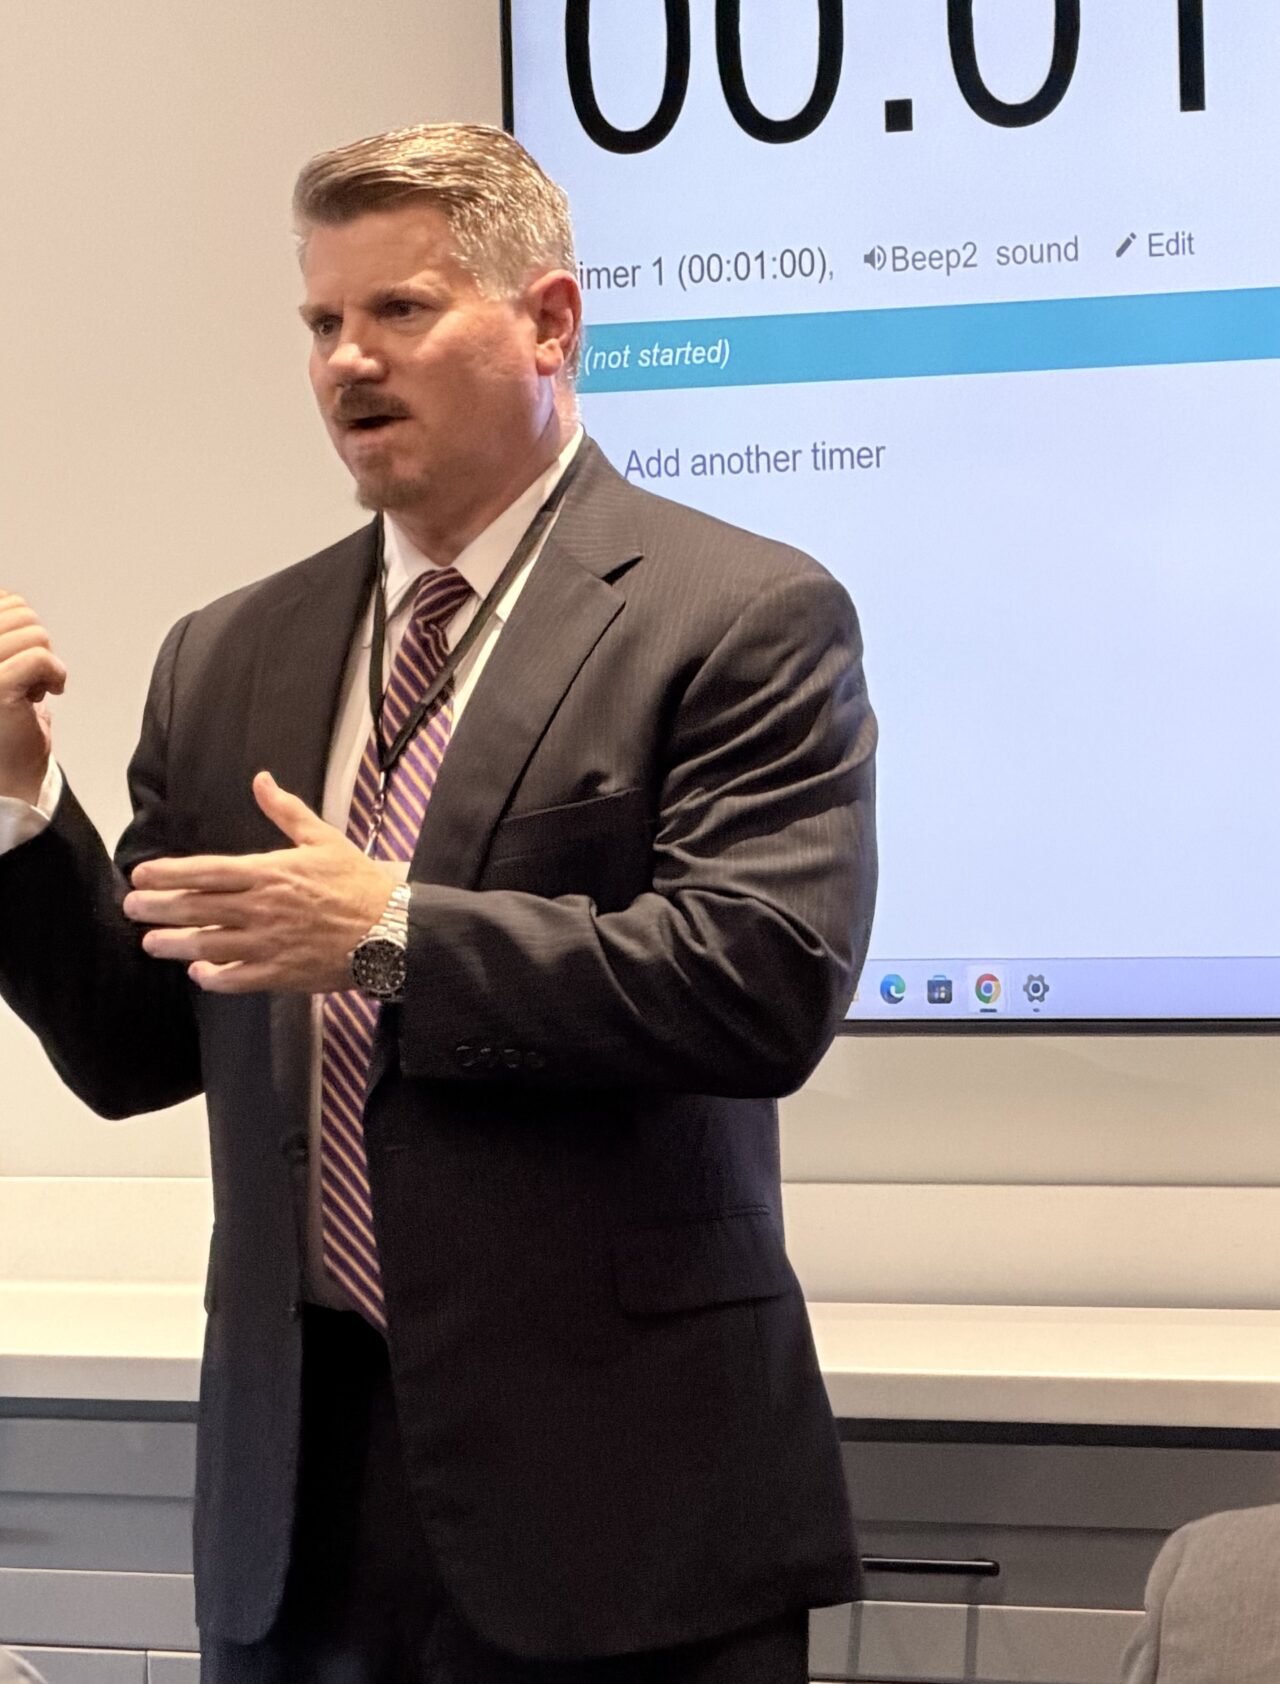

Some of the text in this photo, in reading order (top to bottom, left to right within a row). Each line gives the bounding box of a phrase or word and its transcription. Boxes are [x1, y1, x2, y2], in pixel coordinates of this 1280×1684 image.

[575, 230, 1196, 292] imer 1 (00:01:00), Beep2 sound Edit
[583, 338, 731, 377] (not started)
[624, 440, 887, 481] Add another timer
